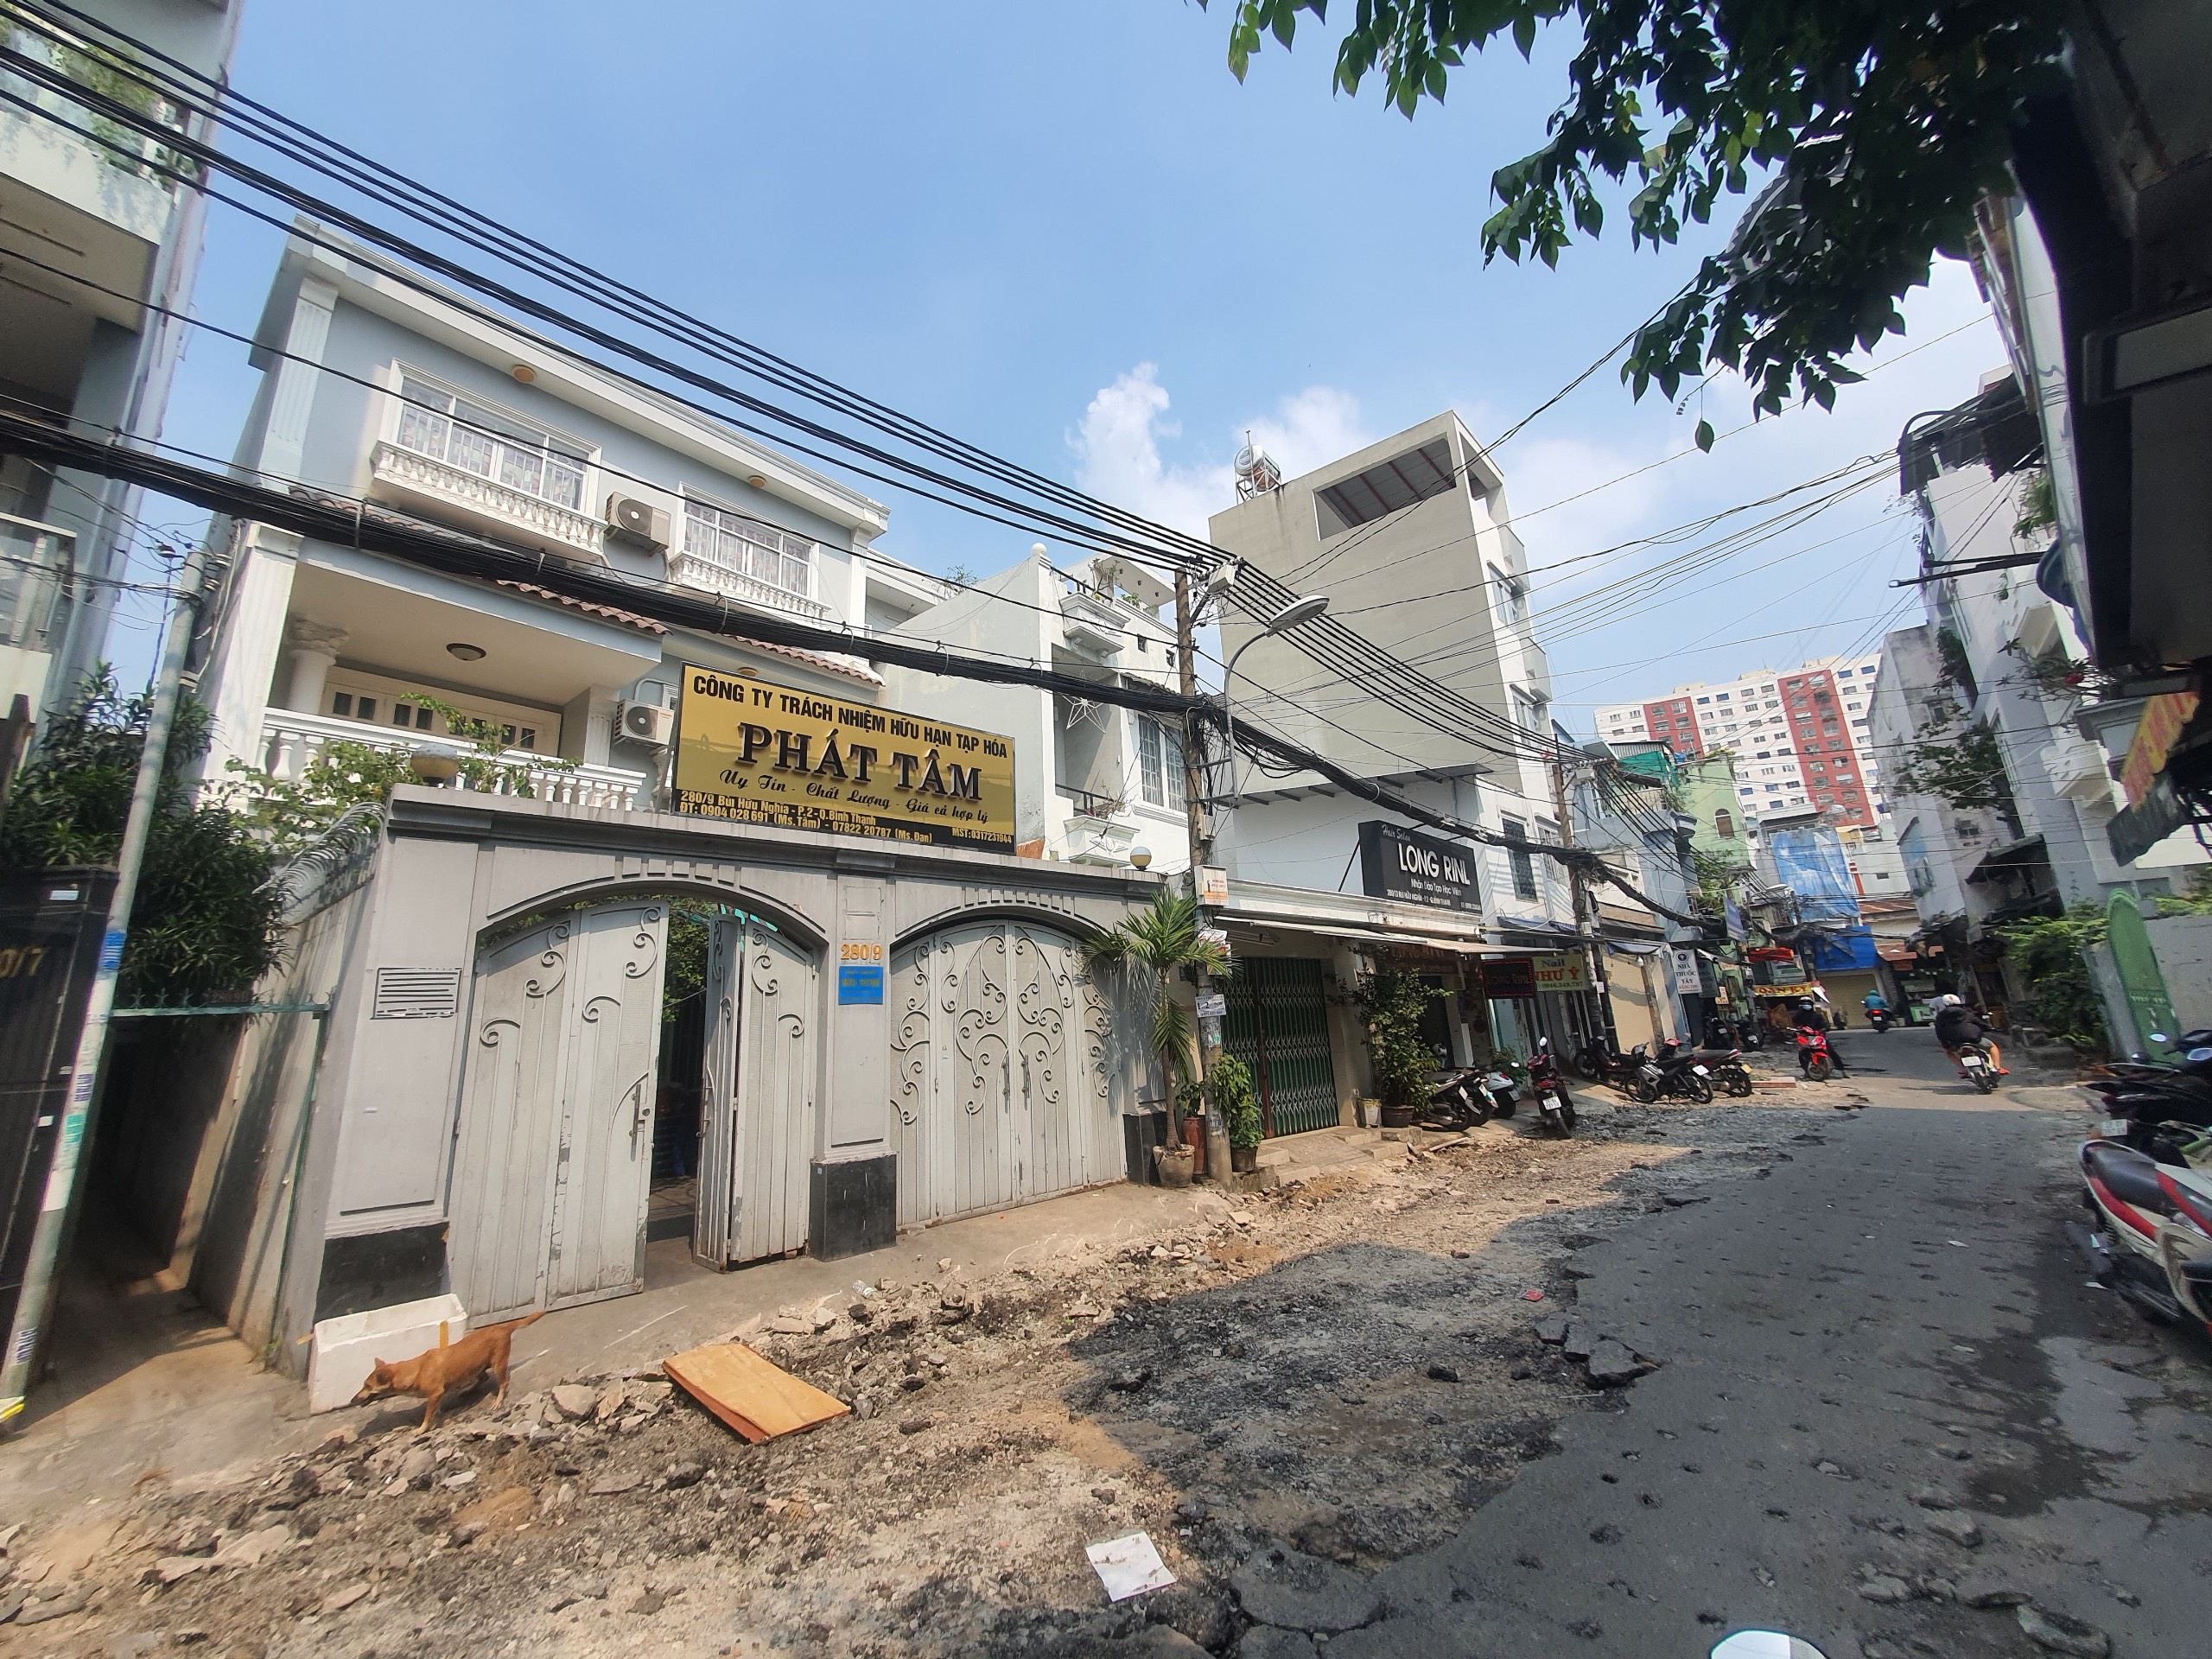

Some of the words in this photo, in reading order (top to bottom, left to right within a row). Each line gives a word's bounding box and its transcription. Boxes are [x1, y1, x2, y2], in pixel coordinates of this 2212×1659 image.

[694, 675, 744, 702] CÔNG
[752, 688, 772, 709] TY
[780, 694, 833, 721] TRÁCH
[838, 708, 885, 734] NHIỆM
[891, 717, 919, 740] HỮU
[925, 726, 951, 747] HẠN
[957, 734, 979, 753] TẠP
[983, 739, 1007, 759] HÓA
[736, 721, 877, 785] PHÁT
[889, 748, 982, 802] TÂM
[681, 791, 714, 805] 280/9
[720, 769, 747, 789] Uy
[758, 774, 787, 792] Tín
[806, 782, 839, 799] Chất
[847, 789, 891, 810] Lượng
[906, 798, 929, 814] Giá
[934, 804, 948, 816] cả
[952, 805, 974, 822] hợp
[976, 810, 988, 823] lý
[680, 801, 698, 814] ĐT:
[700, 804, 728, 817] 0904
[729, 808, 749, 820] 028
[751, 811, 768, 823] 691
[832, 821, 861, 834] 07822
[864, 823, 892, 837] 20787
[1397, 842, 1440, 878] LONG
[1443, 855, 1471, 885] RINL
[840, 943, 882, 963] 280/9
[1541, 958, 1566, 968] Nail
